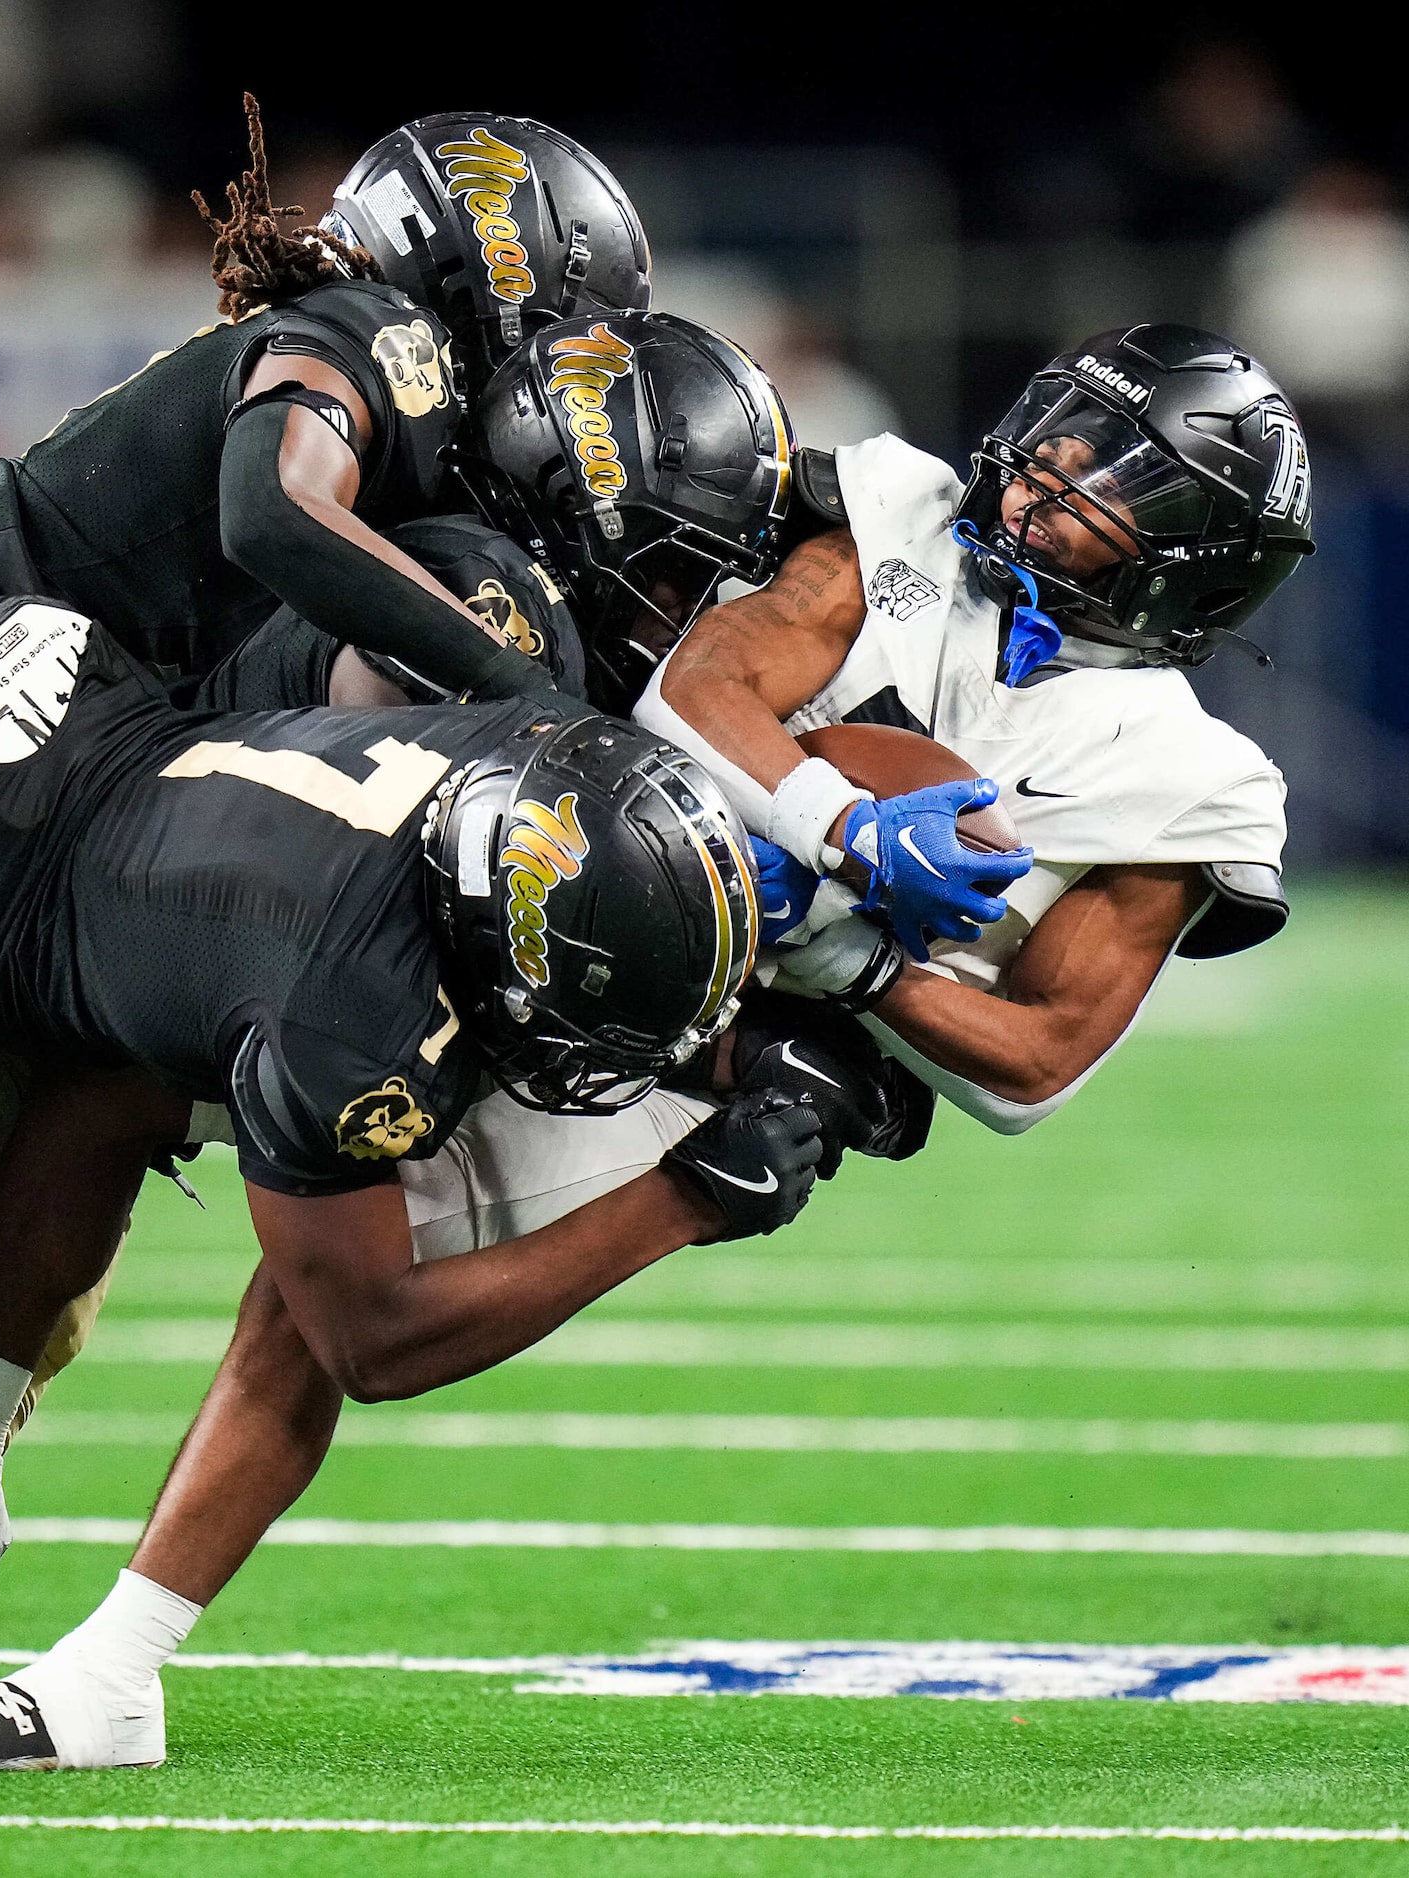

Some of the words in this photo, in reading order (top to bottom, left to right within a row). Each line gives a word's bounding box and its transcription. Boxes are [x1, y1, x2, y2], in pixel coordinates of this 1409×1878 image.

[434, 127, 537, 305] Mecca
[547, 322, 635, 499] Mecca
[1075, 355, 1149, 404] Riddell
[10, 658, 30, 677] Star
[29, 639, 52, 658] Lone
[49, 627, 66, 641] The
[158, 736, 452, 837] 7
[500, 791, 590, 989] Mecca
